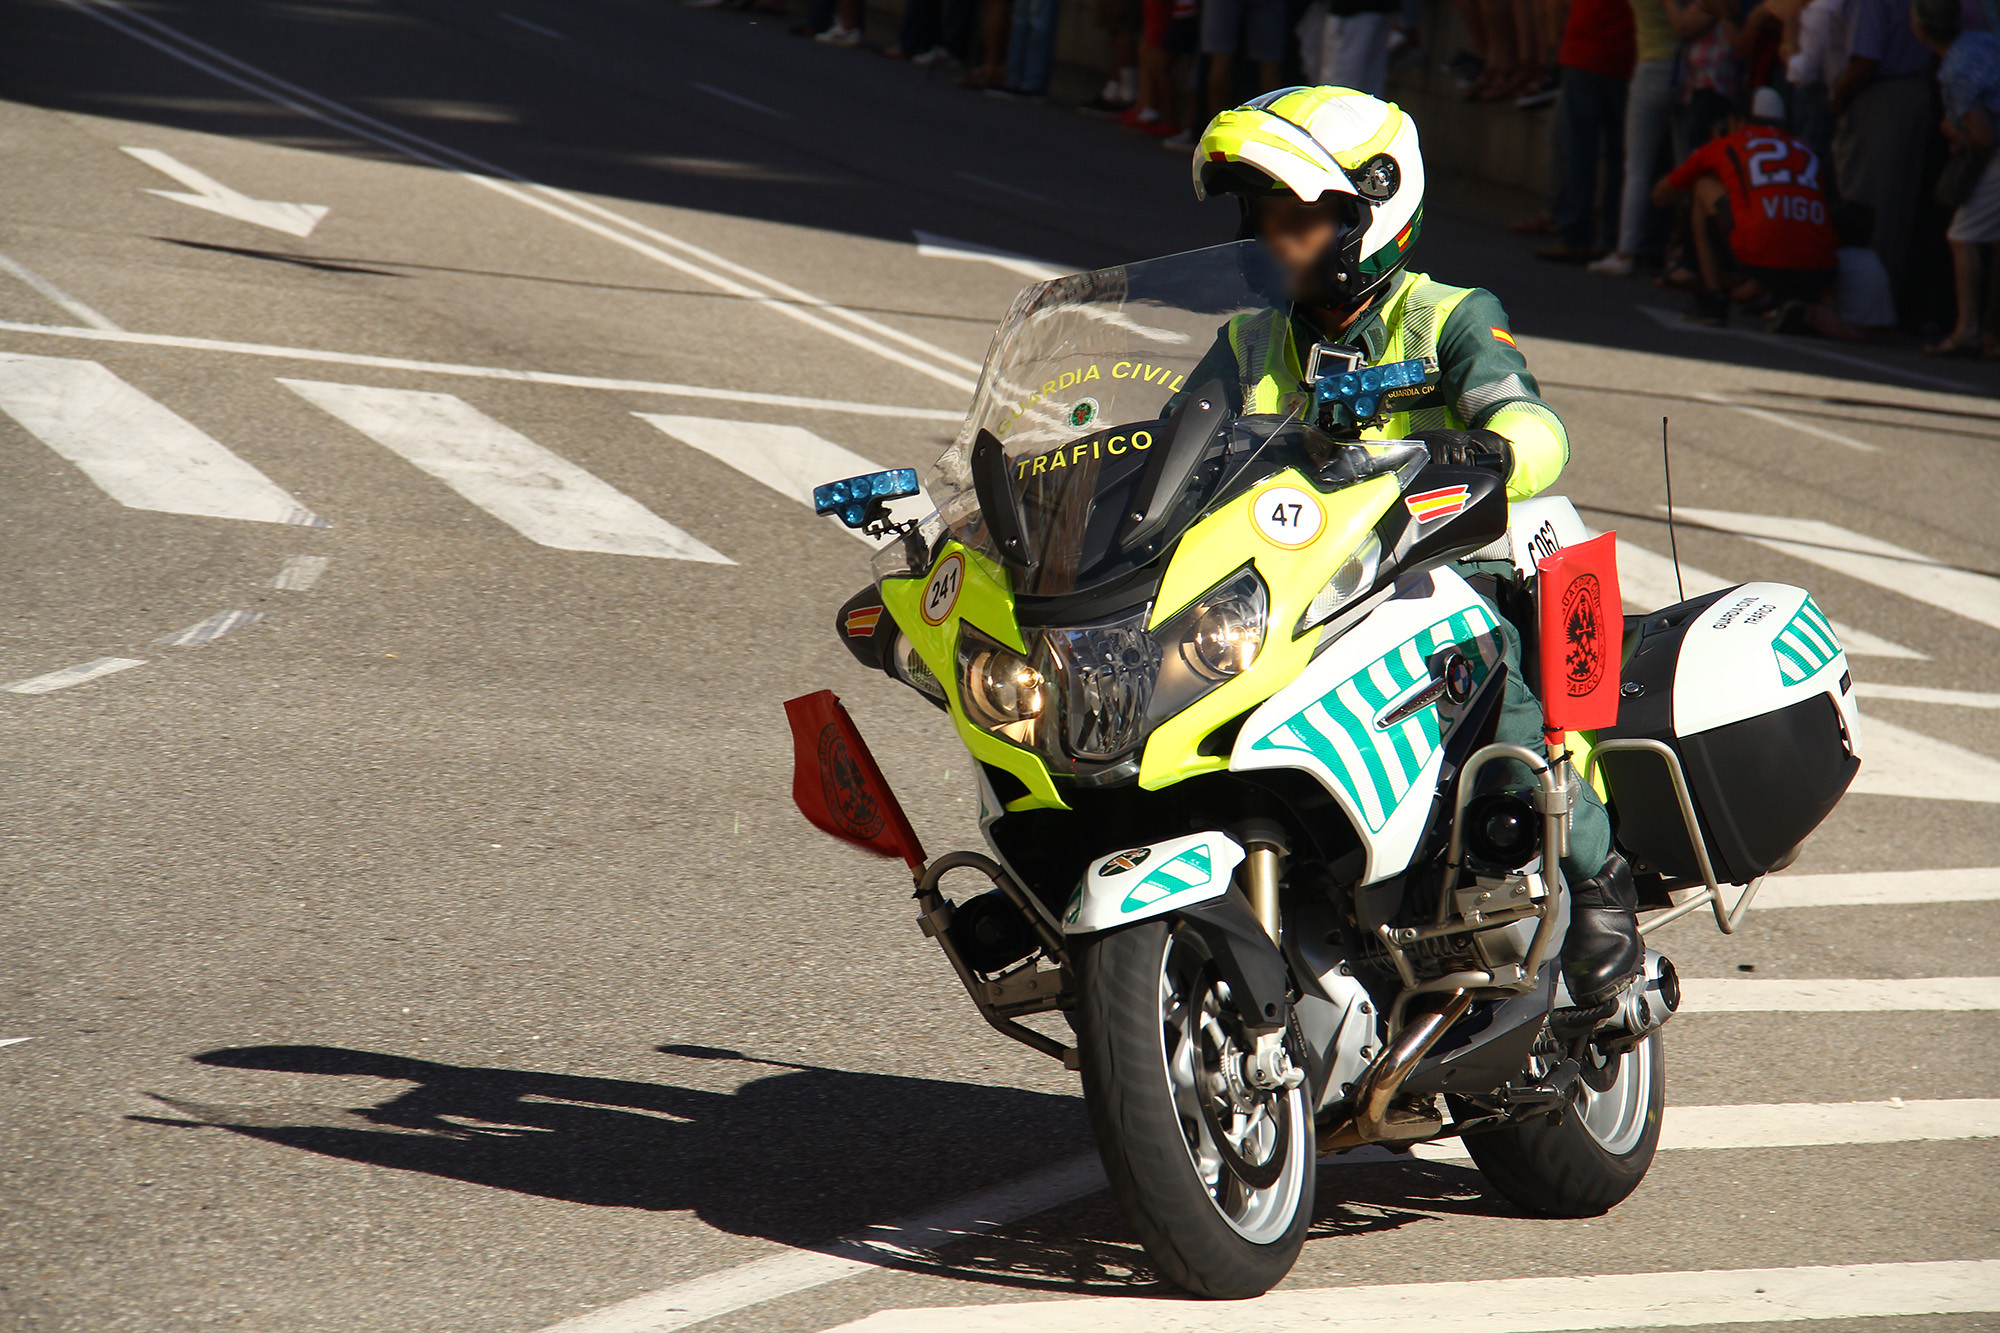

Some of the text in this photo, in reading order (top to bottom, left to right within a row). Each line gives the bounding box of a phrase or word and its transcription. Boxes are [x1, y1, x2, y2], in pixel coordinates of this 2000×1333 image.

[1762, 195, 1825, 225] VIGO
[996, 363, 1101, 435] GUARDIA
[1111, 361, 1185, 393] CIVIL
[1016, 430, 1153, 481] TRÁFICO
[1271, 503, 1303, 528] 47
[930, 567, 958, 609] 241
